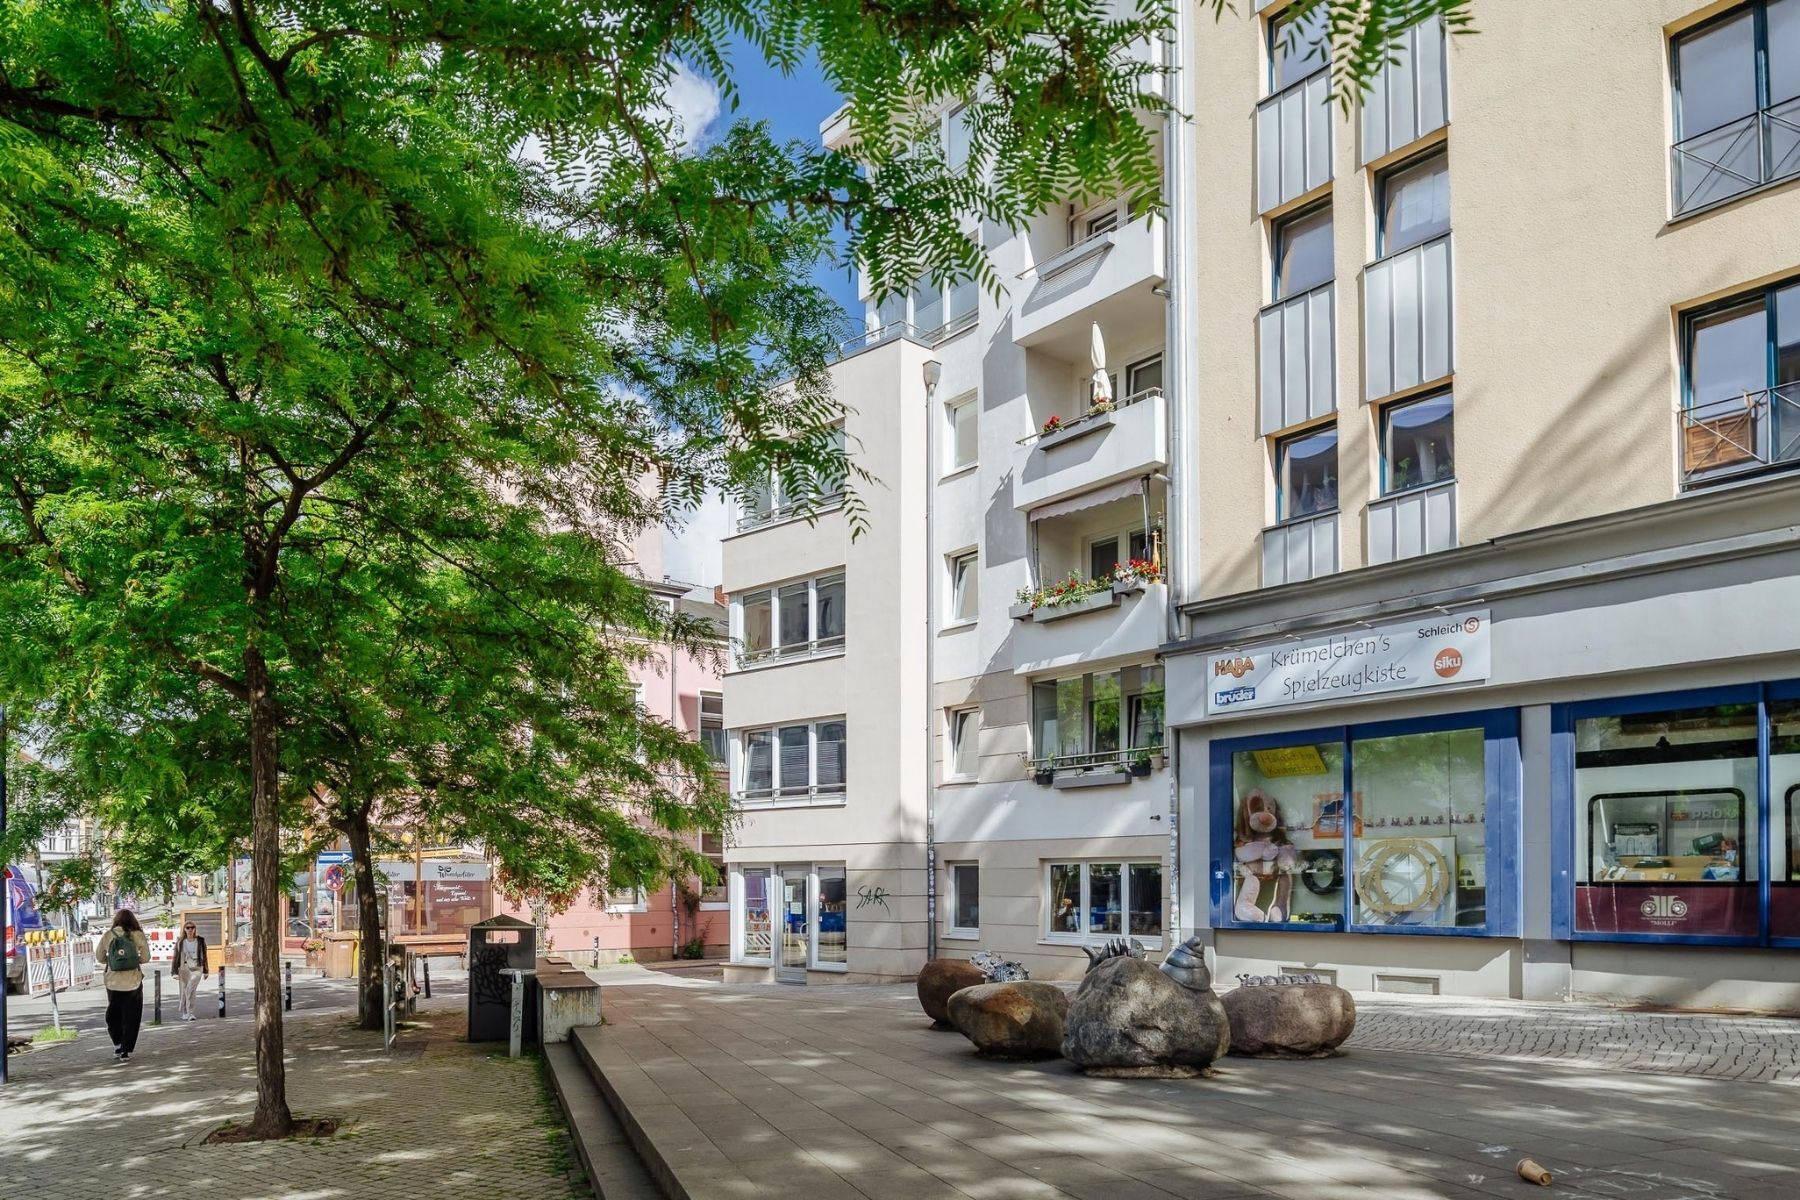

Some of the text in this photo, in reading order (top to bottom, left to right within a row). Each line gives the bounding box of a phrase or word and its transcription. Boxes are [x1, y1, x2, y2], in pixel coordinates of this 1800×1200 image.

[1418, 623, 1463, 639] Schleich
[1271, 634, 1391, 669] Krümelchen's
[1215, 656, 1255, 678] HABA
[1435, 656, 1462, 670] siku
[1283, 662, 1407, 700] Spielzeugkiste
[1216, 689, 1254, 704] bruder
